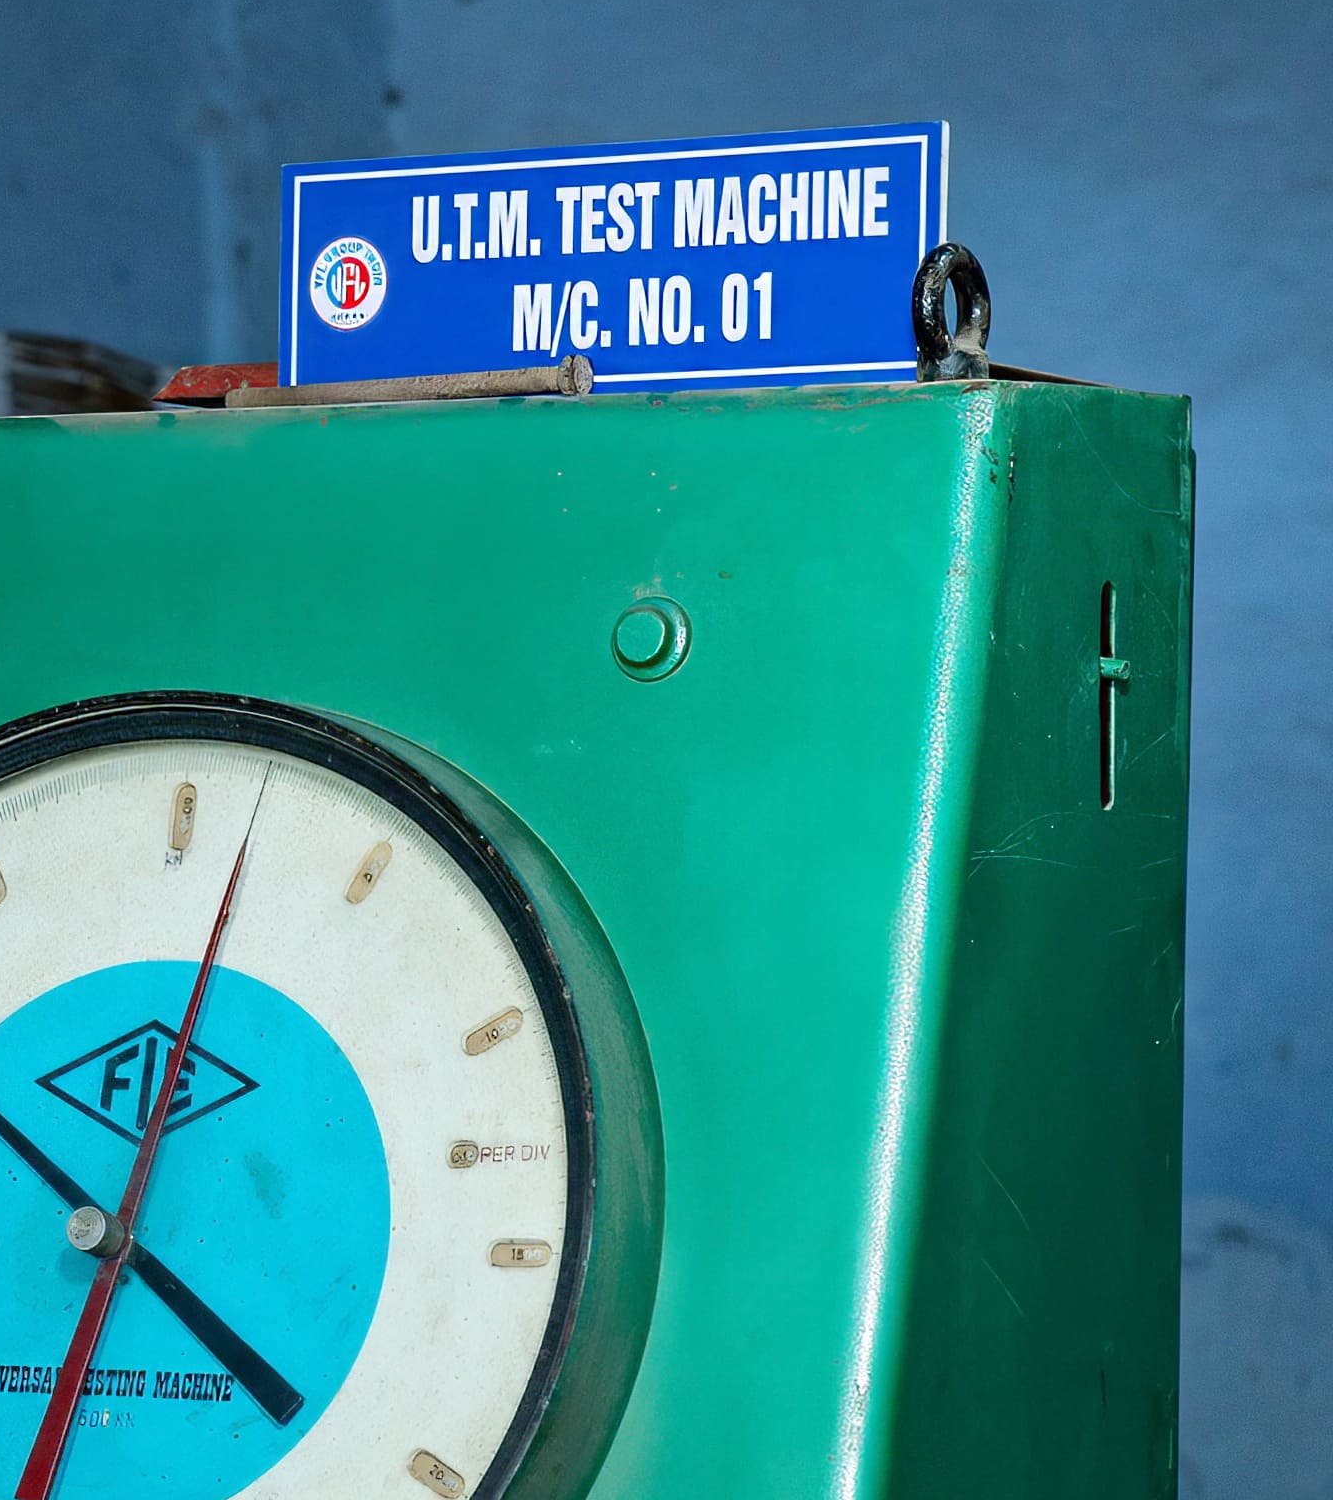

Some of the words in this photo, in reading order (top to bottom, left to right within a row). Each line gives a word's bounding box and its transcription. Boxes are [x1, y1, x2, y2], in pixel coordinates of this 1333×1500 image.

[411, 189, 542, 264] U.T.M.
[555, 181, 661, 256] TEST
[673, 166, 891, 249] MACHINE
[511, 279, 612, 358] M/C.
[628, 274, 705, 348] NO.
[720, 271, 774, 342] 01
[100, 1036, 196, 1131] FIE
[480, 1145, 515, 1163] PER
[521, 1144, 551, 1161] DIV
[80, 1368, 147, 1398] ESTING
[152, 1370, 234, 1402] MACHINE
